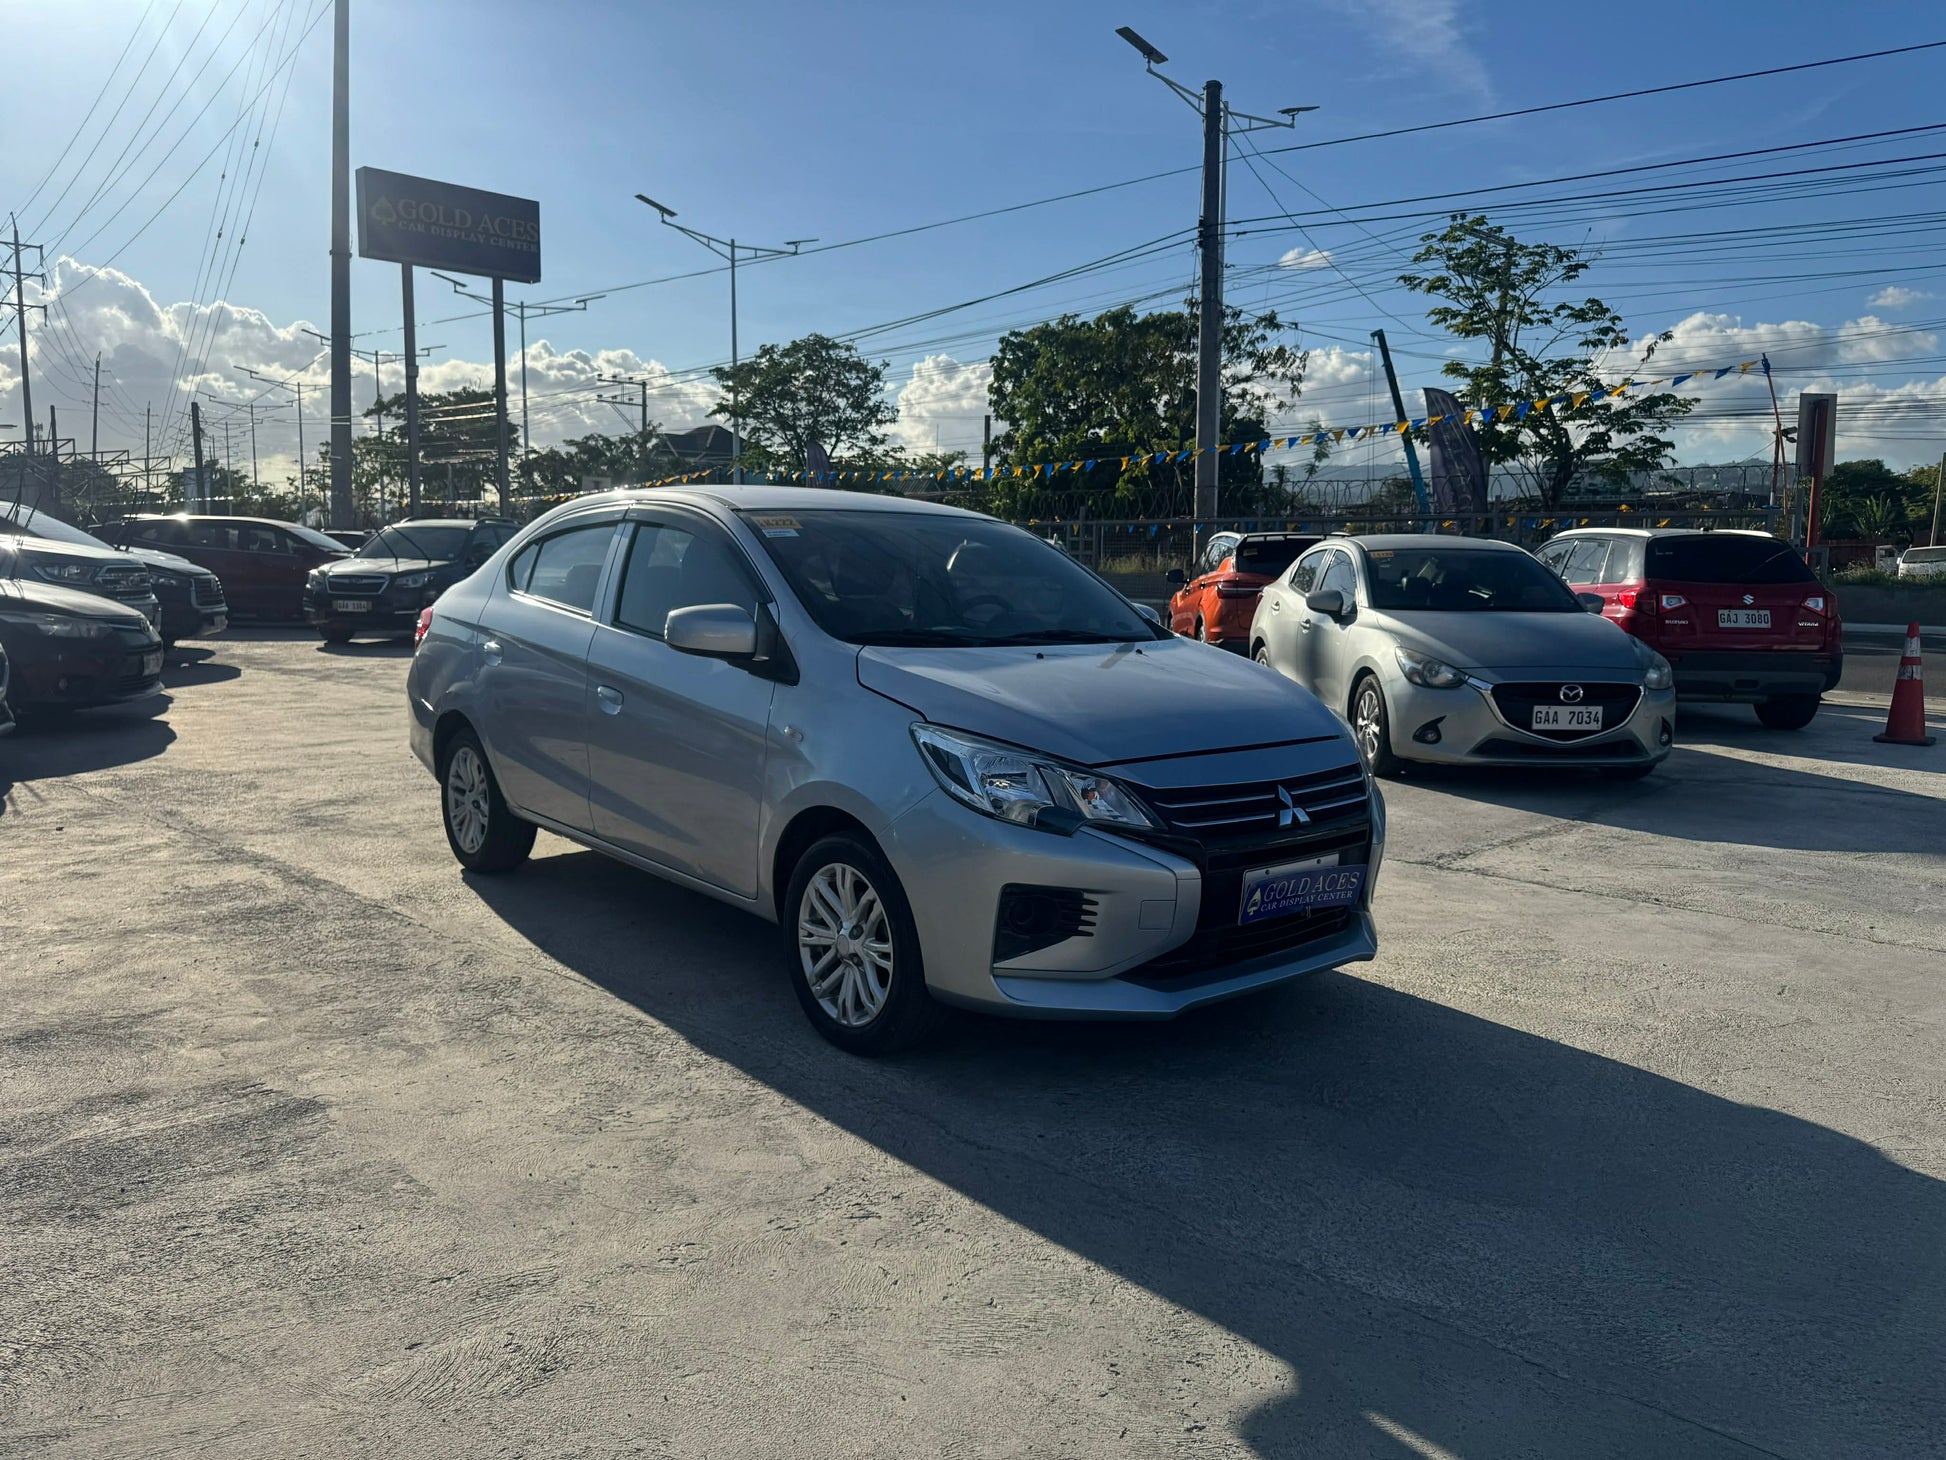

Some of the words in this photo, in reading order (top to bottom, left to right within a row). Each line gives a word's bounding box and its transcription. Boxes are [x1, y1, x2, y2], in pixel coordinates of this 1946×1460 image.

[398, 198, 472, 229] GOLD
[479, 214, 538, 242] ACES
[398, 219, 425, 233] CAR
[431, 226, 486, 244] DISPLAY
[489, 236, 538, 253] CENTER
[1719, 612, 1739, 625] GAJ
[1535, 710, 1559, 725] GAA
[1568, 710, 1600, 725] 7034
[1263, 877, 1311, 902] GOLD
[1312, 871, 1360, 892] ACES
[1260, 901, 1278, 912] CAR
[1278, 894, 1316, 908] DISPLAY
[1317, 890, 1353, 902] CENTER
